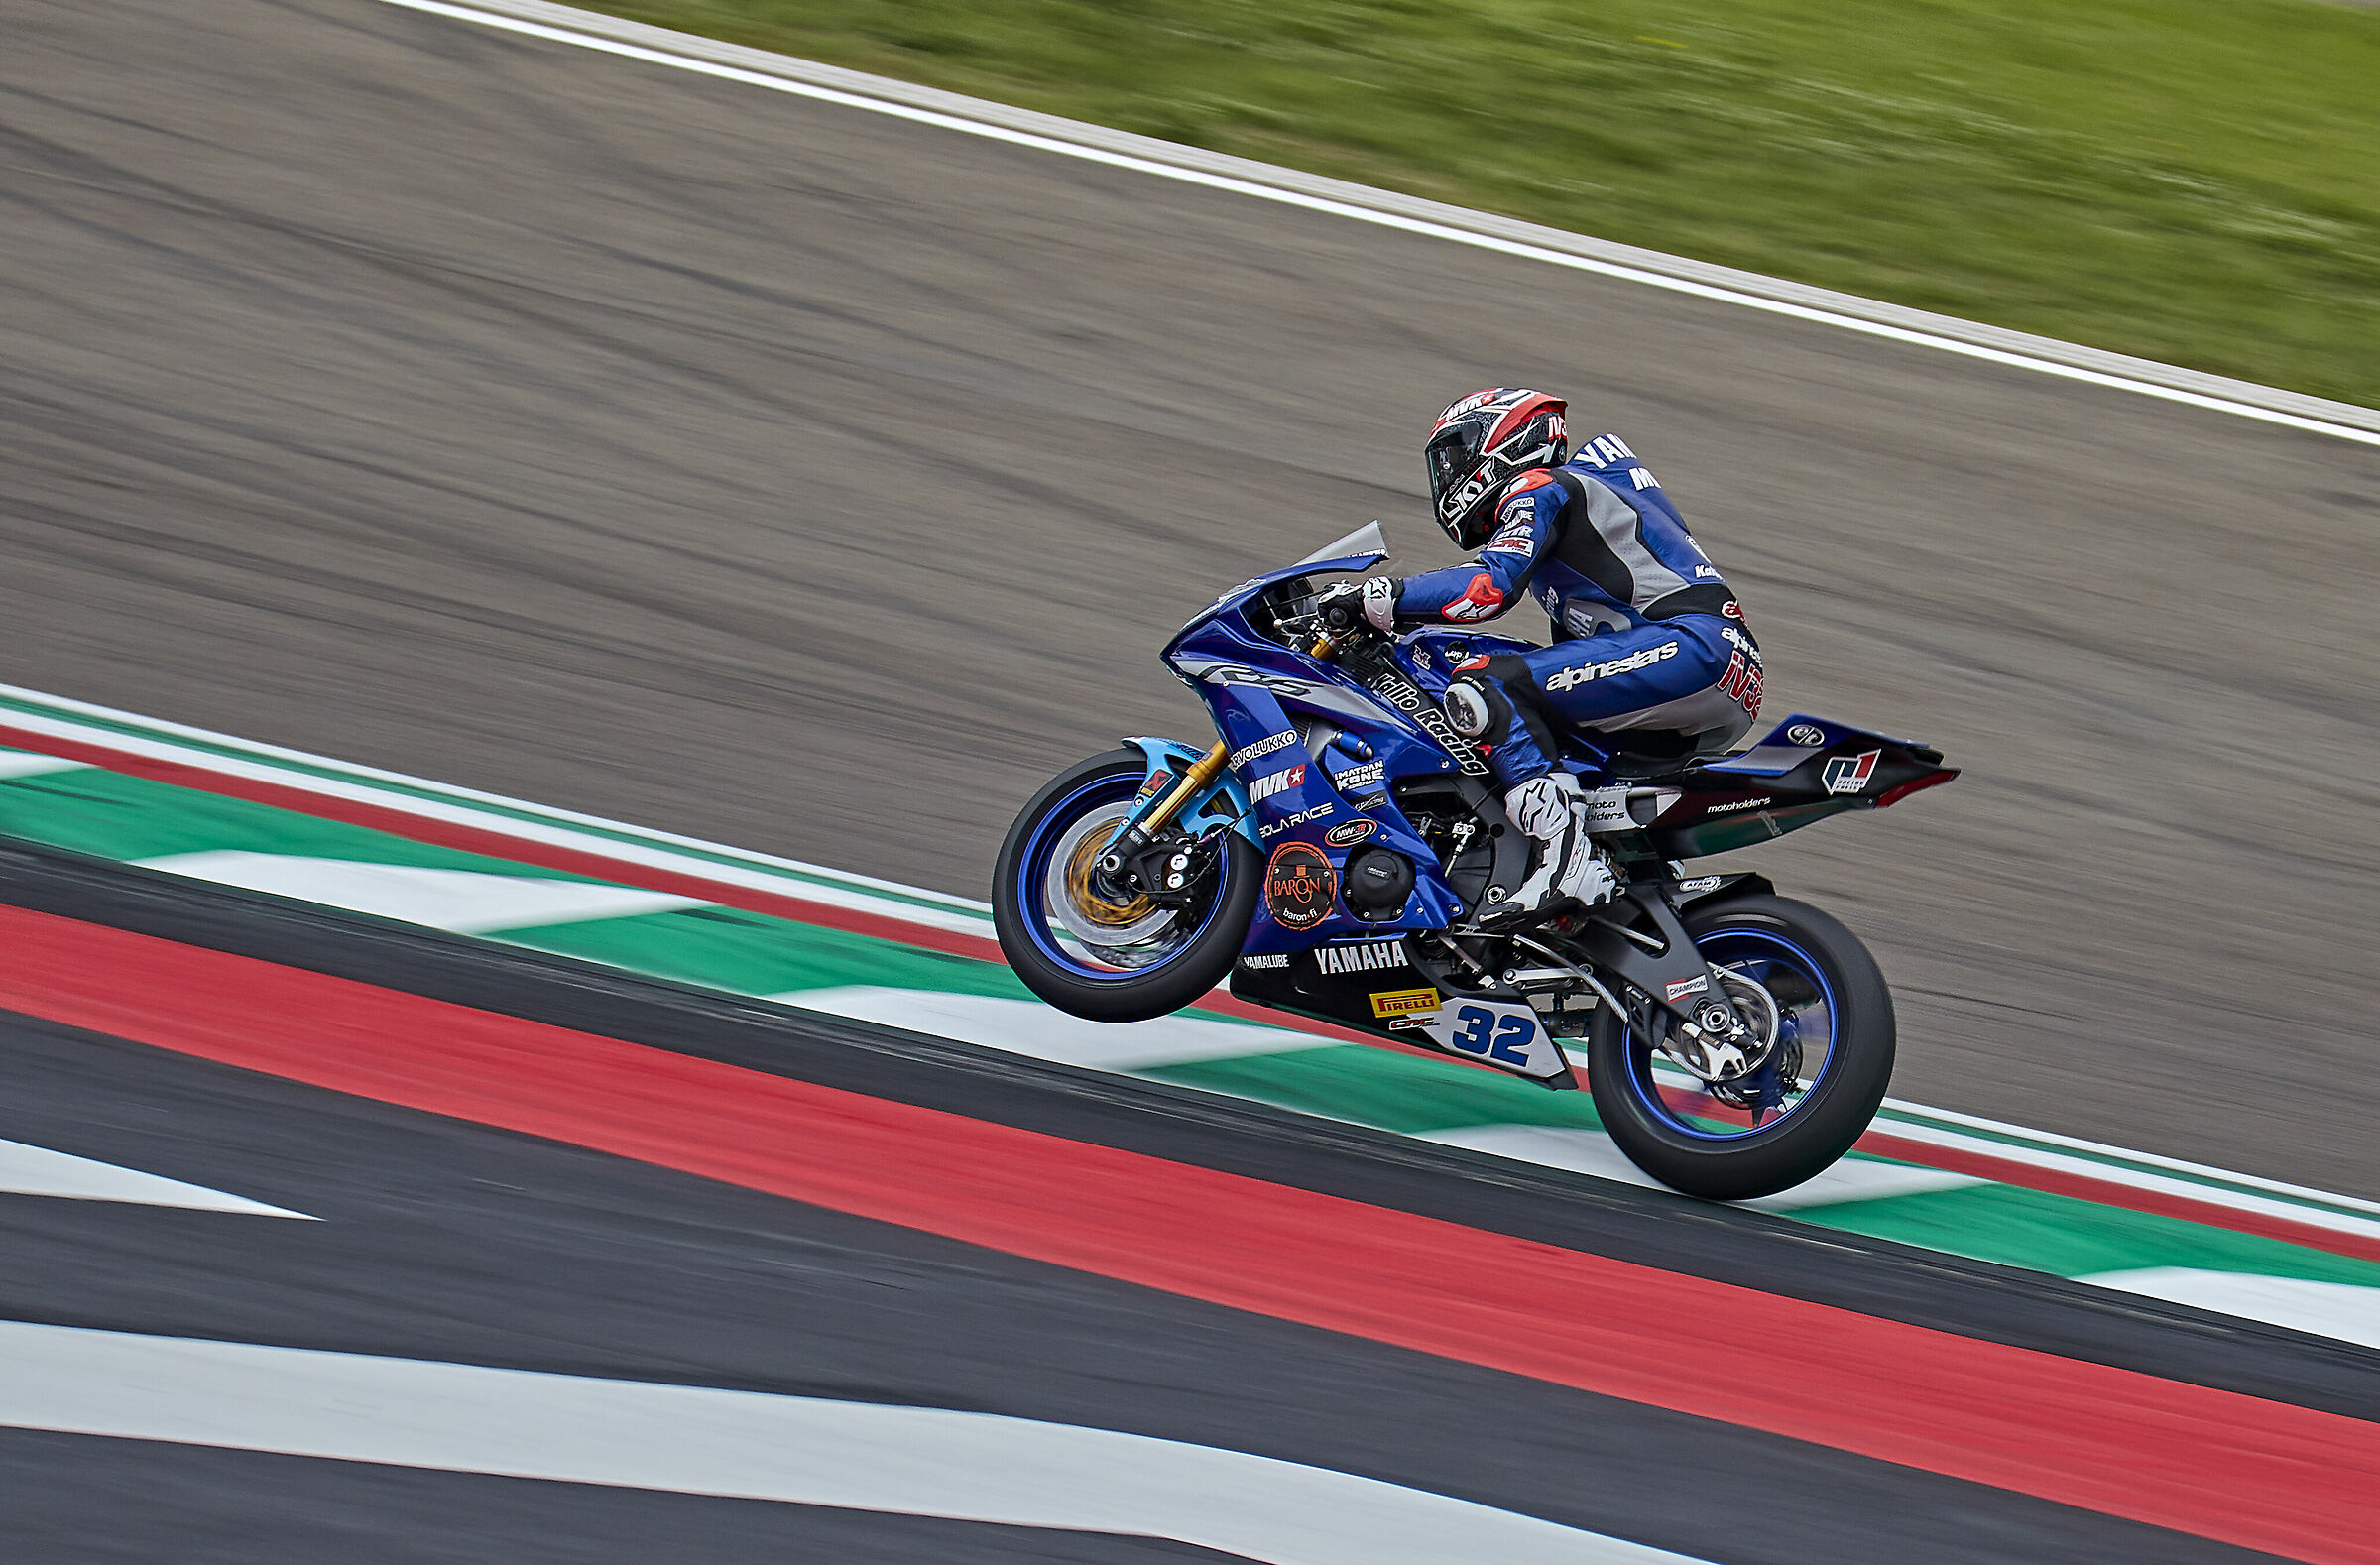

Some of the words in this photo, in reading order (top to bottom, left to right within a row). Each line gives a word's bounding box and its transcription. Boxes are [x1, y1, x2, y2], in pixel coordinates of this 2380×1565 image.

[1546, 641, 1678, 692] alpinestars
[1413, 708, 1489, 776] Racing
[1334, 760, 1384, 781] IMATRAN
[1336, 769, 1385, 791] KONE
[1249, 769, 1290, 805] MVK
[1707, 797, 1771, 814] motoholders
[1274, 878, 1321, 903] BARON
[1244, 954, 1289, 969] YAMALUBE
[1314, 940, 1409, 975] YAMAHA
[1669, 978, 1706, 996] CHAMPION
[1376, 993, 1436, 1012] PIRELLI
[1452, 1004, 1536, 1068] 32
